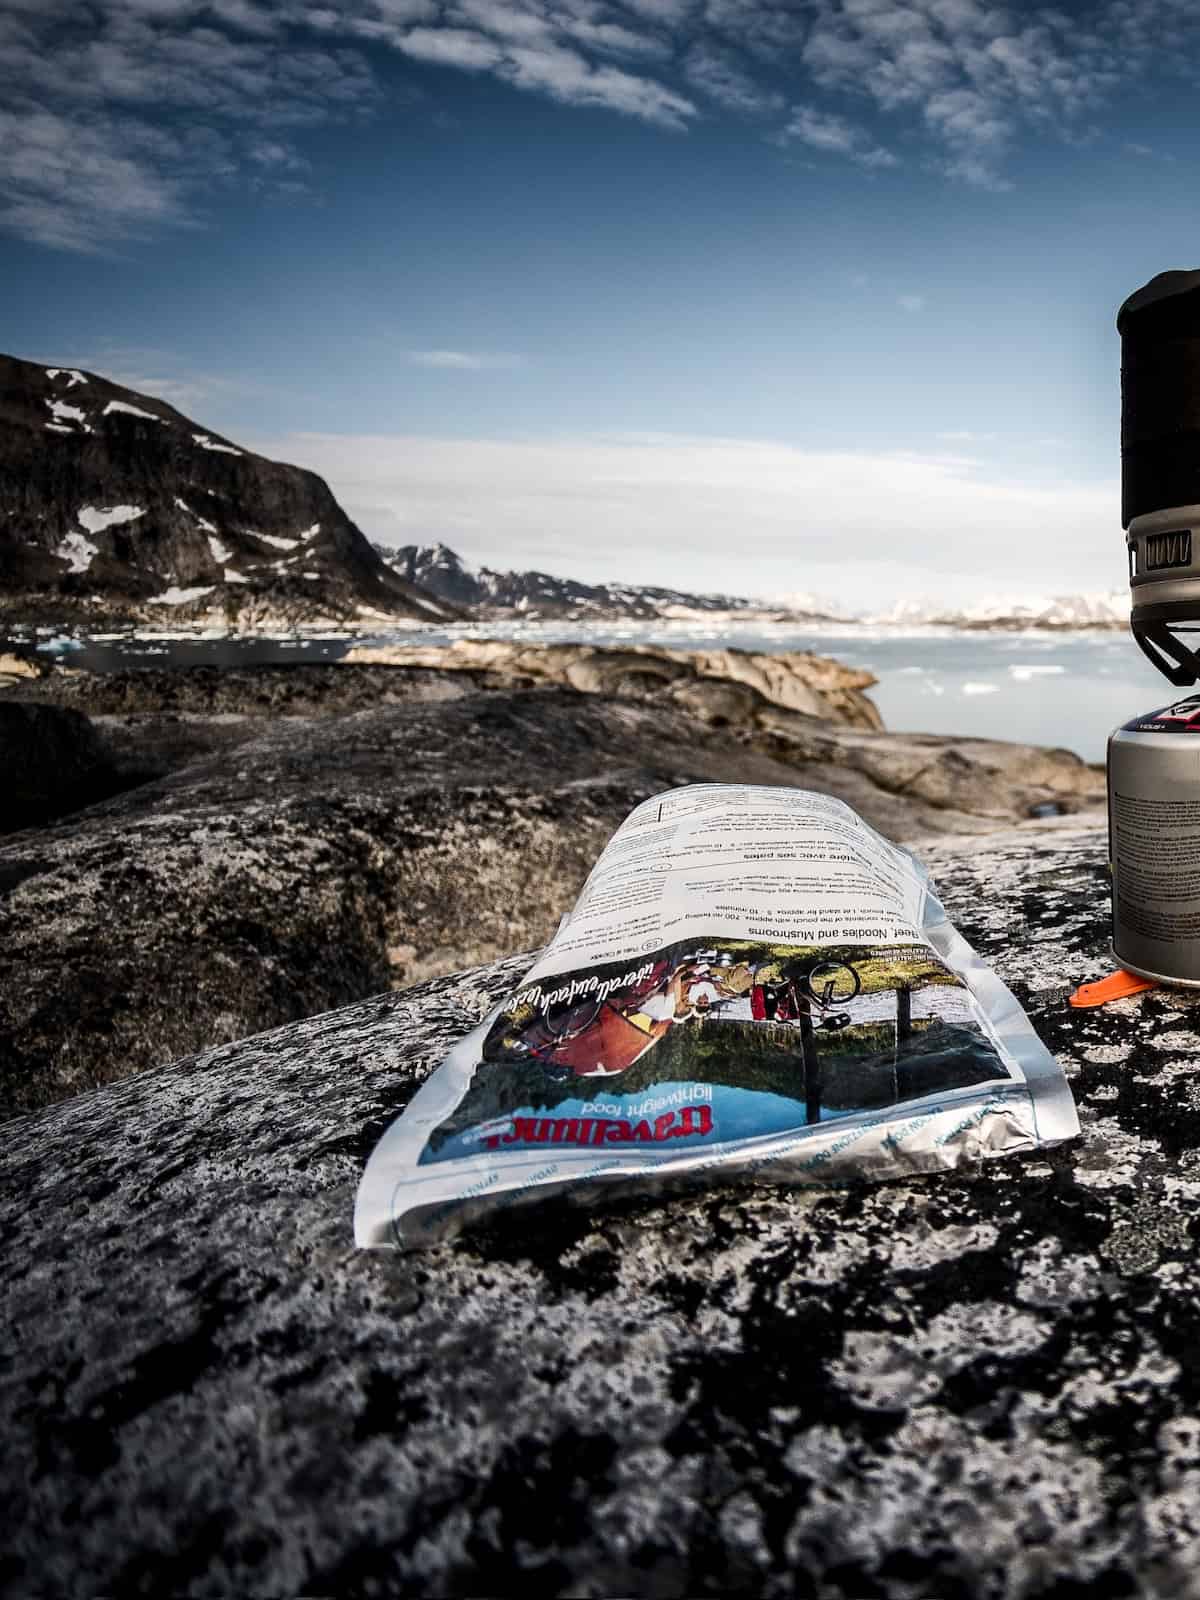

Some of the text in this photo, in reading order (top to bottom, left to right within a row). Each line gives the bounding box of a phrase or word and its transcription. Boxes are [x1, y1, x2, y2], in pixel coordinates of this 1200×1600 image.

[748, 927, 815, 941] Mushrooms
[818, 929, 839, 940] and
[842, 928, 887, 940] Noodles
[596, 962, 655, 1003] überall
[540, 976, 599, 1016] einfach
[580, 1084, 713, 1119] lightweight food
